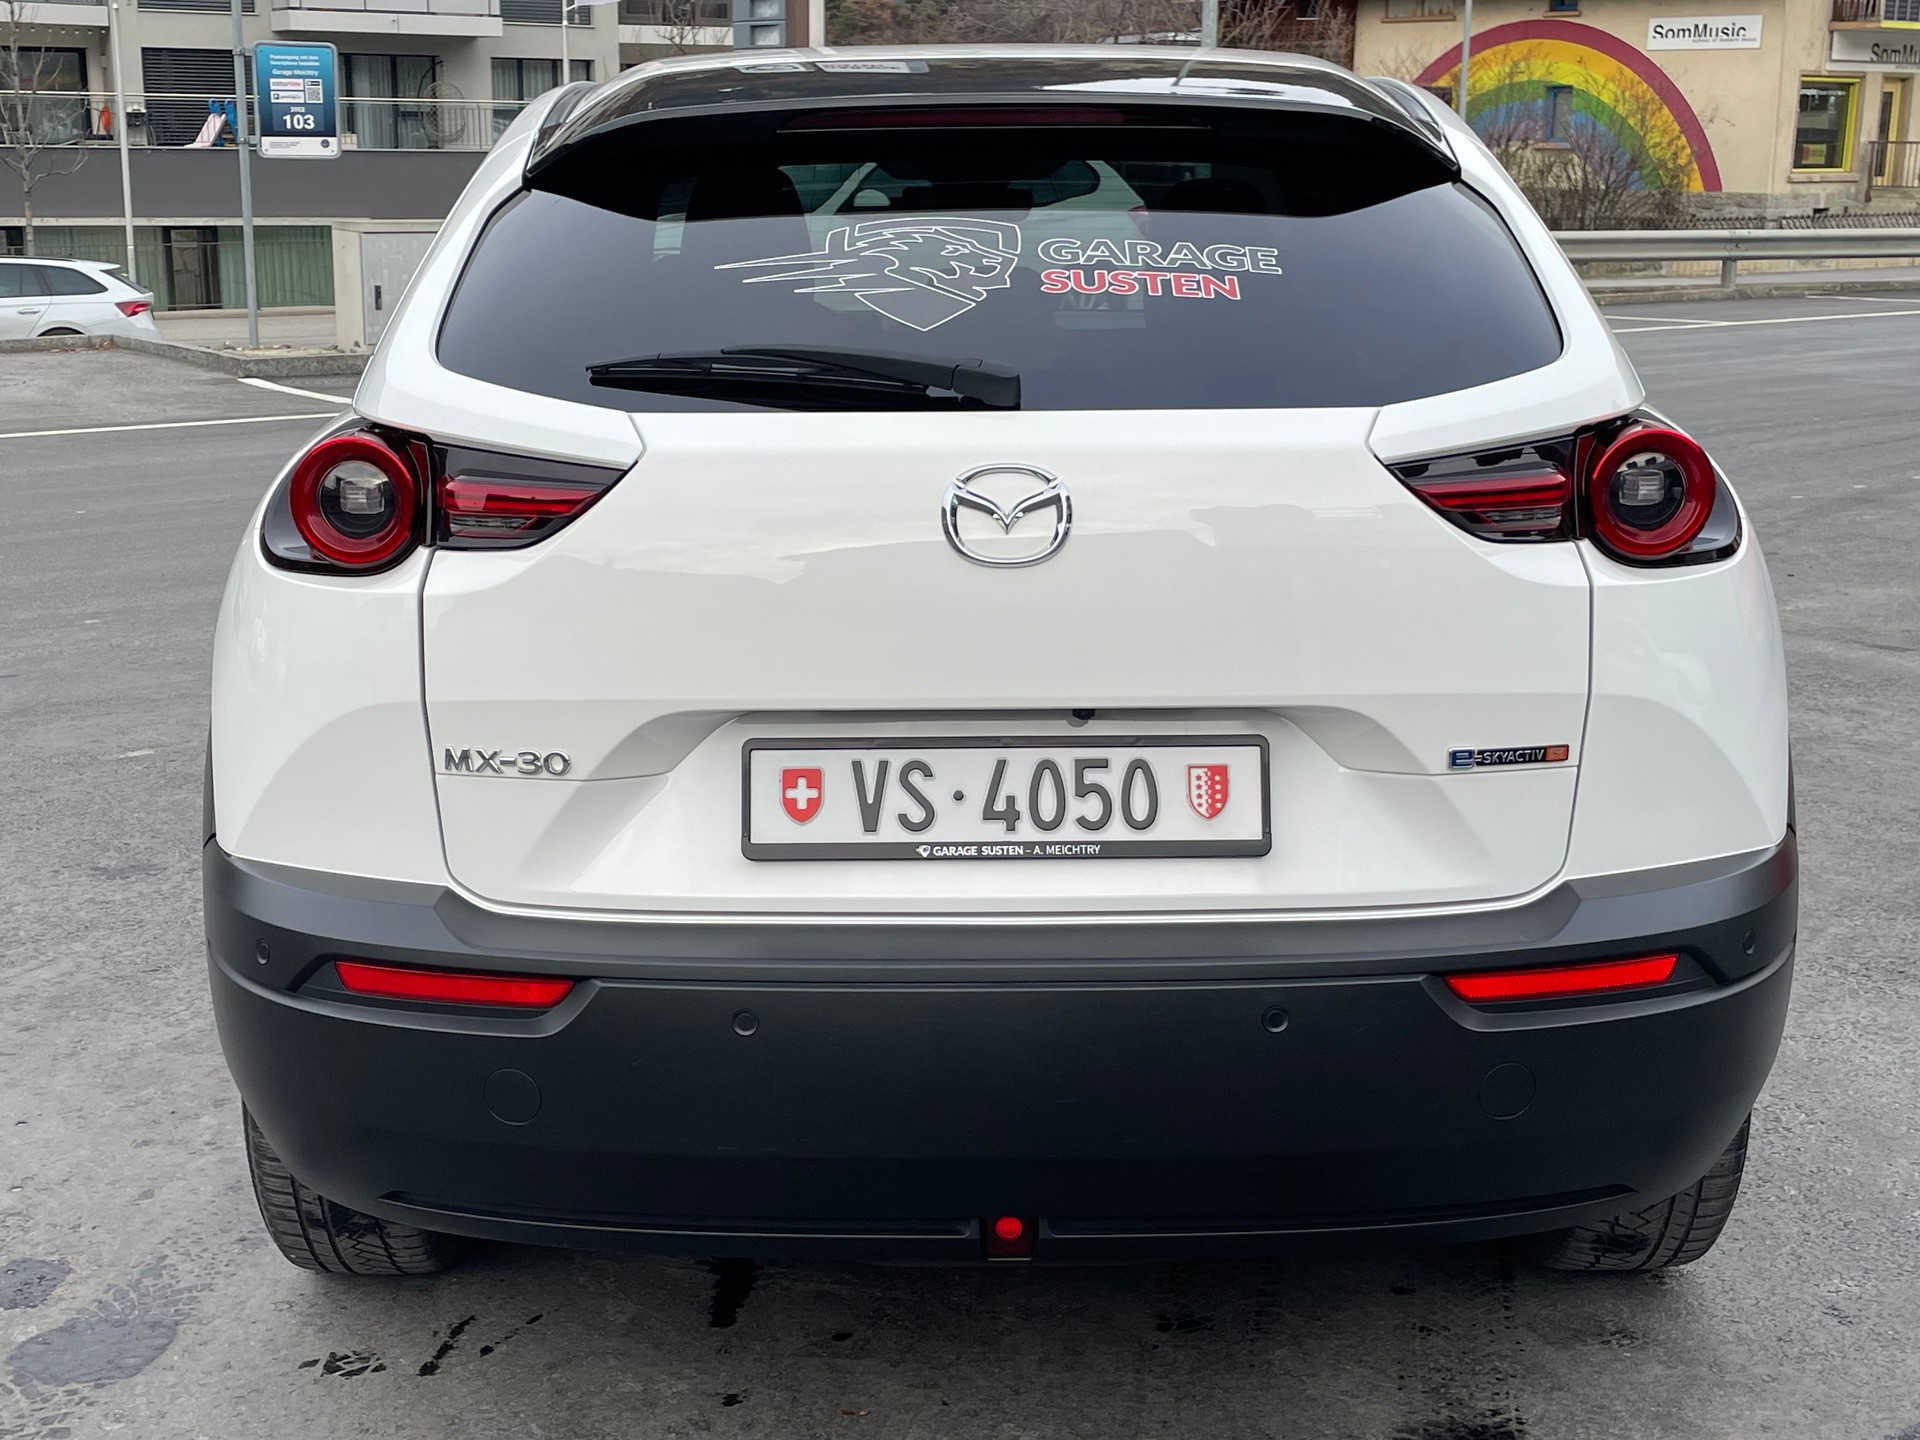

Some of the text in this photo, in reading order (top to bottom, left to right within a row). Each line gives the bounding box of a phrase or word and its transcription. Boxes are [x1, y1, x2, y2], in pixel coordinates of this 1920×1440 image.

[1652, 22, 1747, 39] SomMusic
[272, 68, 293, 76] Garage
[282, 114, 315, 129] 103
[1037, 238, 1283, 275] GARAGE
[1040, 268, 1241, 300] SUSTEN
[444, 745, 572, 776] MX-30
[932, 846, 977, 856] GARAGE
[981, 845, 1024, 856] SUSTEN
[1033, 845, 1043, 855] A.
[1046, 844, 1101, 855] MEICHTRY
